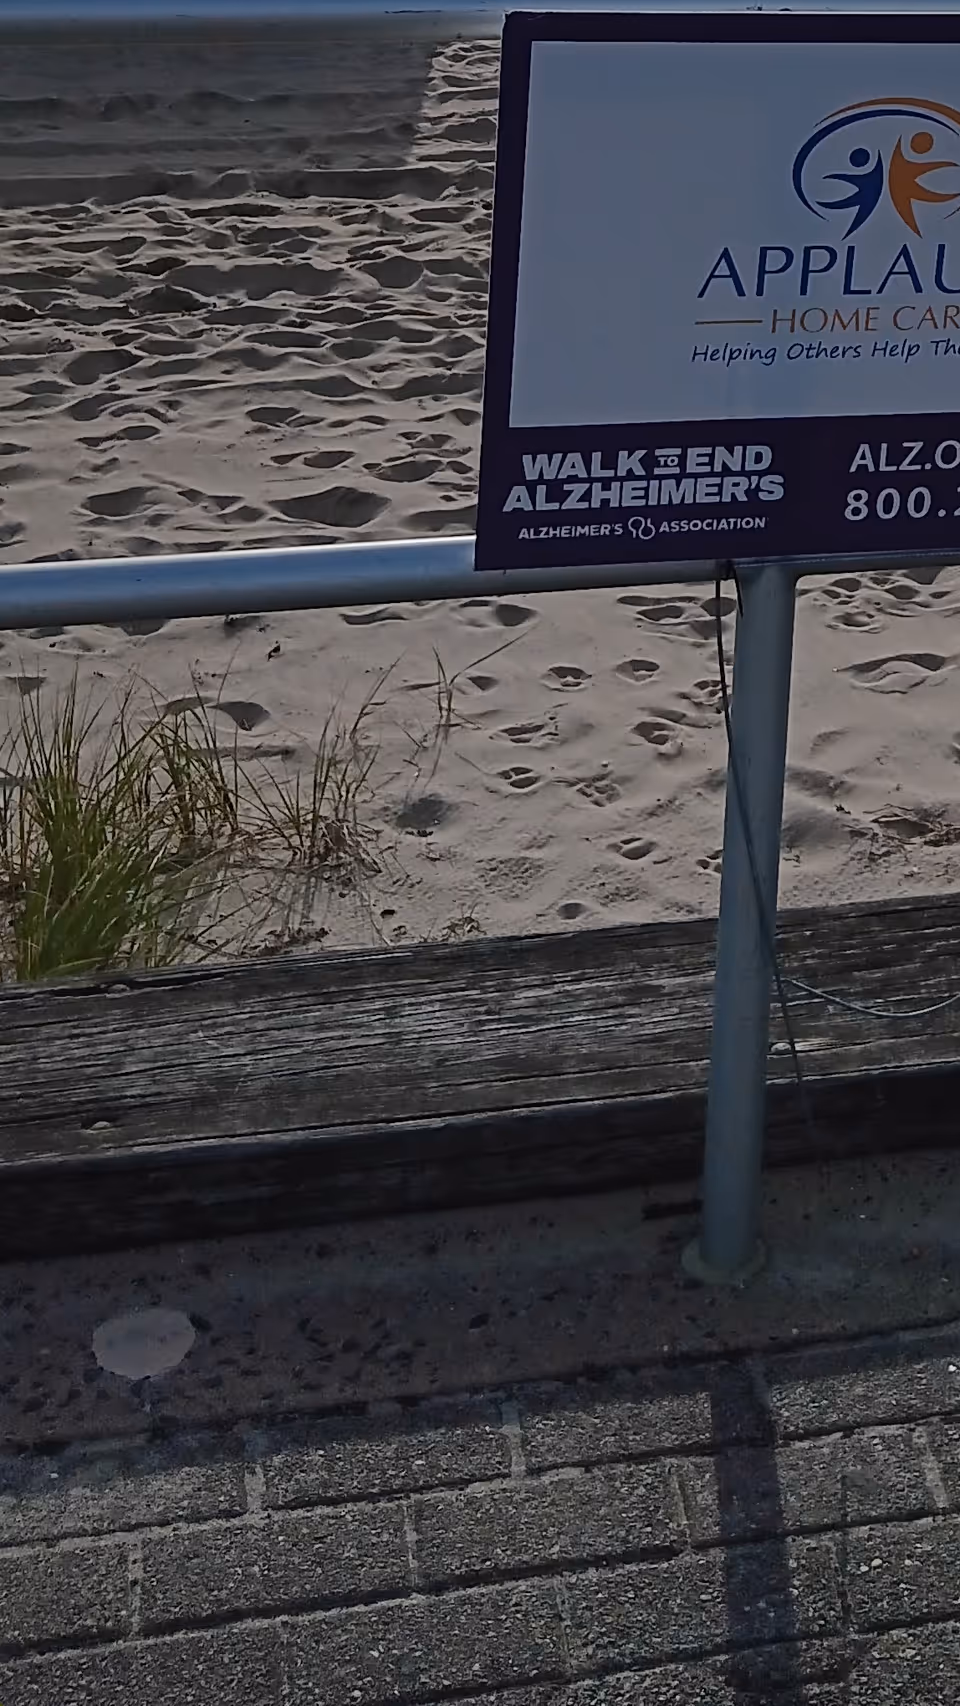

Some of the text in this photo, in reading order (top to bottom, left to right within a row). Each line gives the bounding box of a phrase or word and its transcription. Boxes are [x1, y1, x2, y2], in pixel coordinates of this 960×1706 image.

[770, 306, 880, 334] HOME
[691, 342, 776, 367] Helping
[786, 341, 862, 361] Others
[871, 338, 921, 362] Help
[522, 445, 773, 480] WALK TO END
[502, 474, 785, 512] ALZHEIMER'S
[518, 516, 767, 539] ALZHEIMER'S ASSOCIATION
